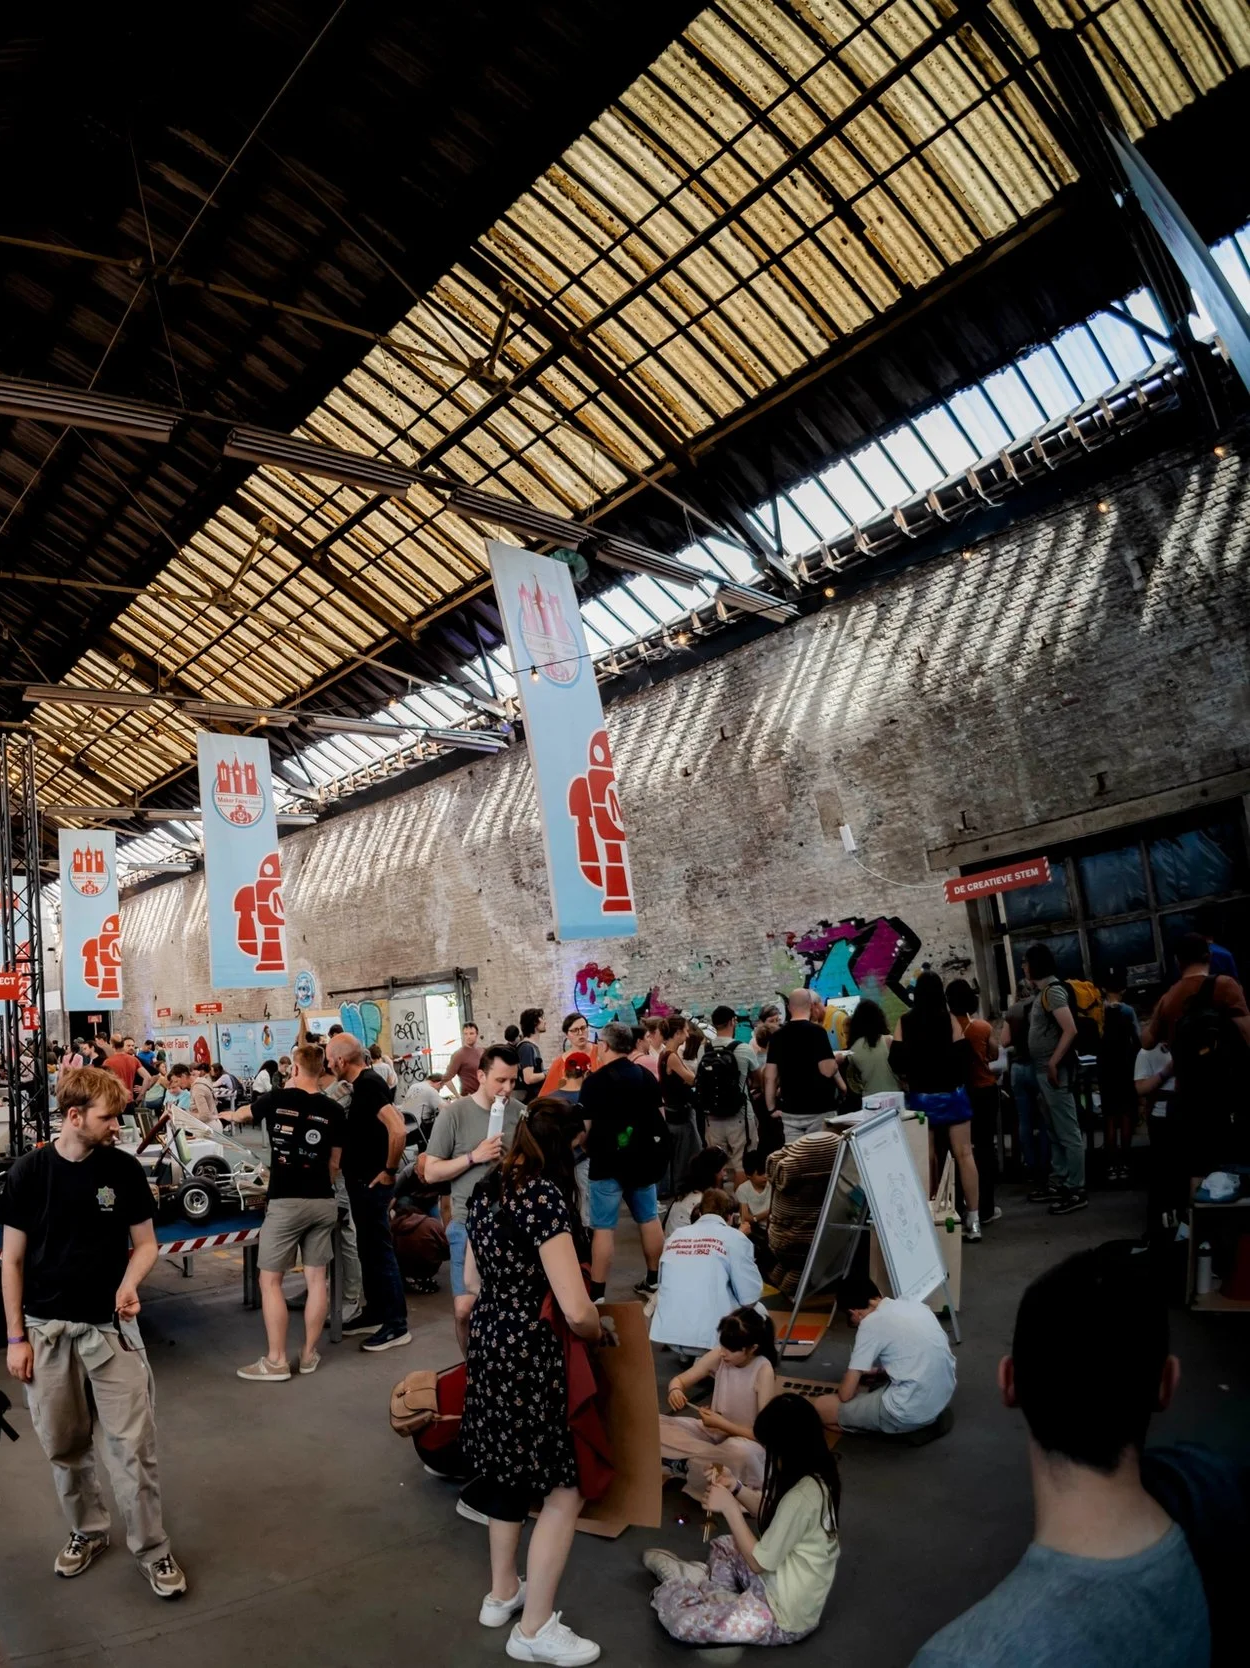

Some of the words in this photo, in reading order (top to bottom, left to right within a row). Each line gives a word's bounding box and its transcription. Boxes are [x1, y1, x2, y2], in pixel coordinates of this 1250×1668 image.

[954, 885, 966, 894] DE
[967, 873, 1013, 891] CREATIEVE
[1014, 867, 1039, 880] STEM
[693, 1244, 726, 1255] ESSENTIALS
